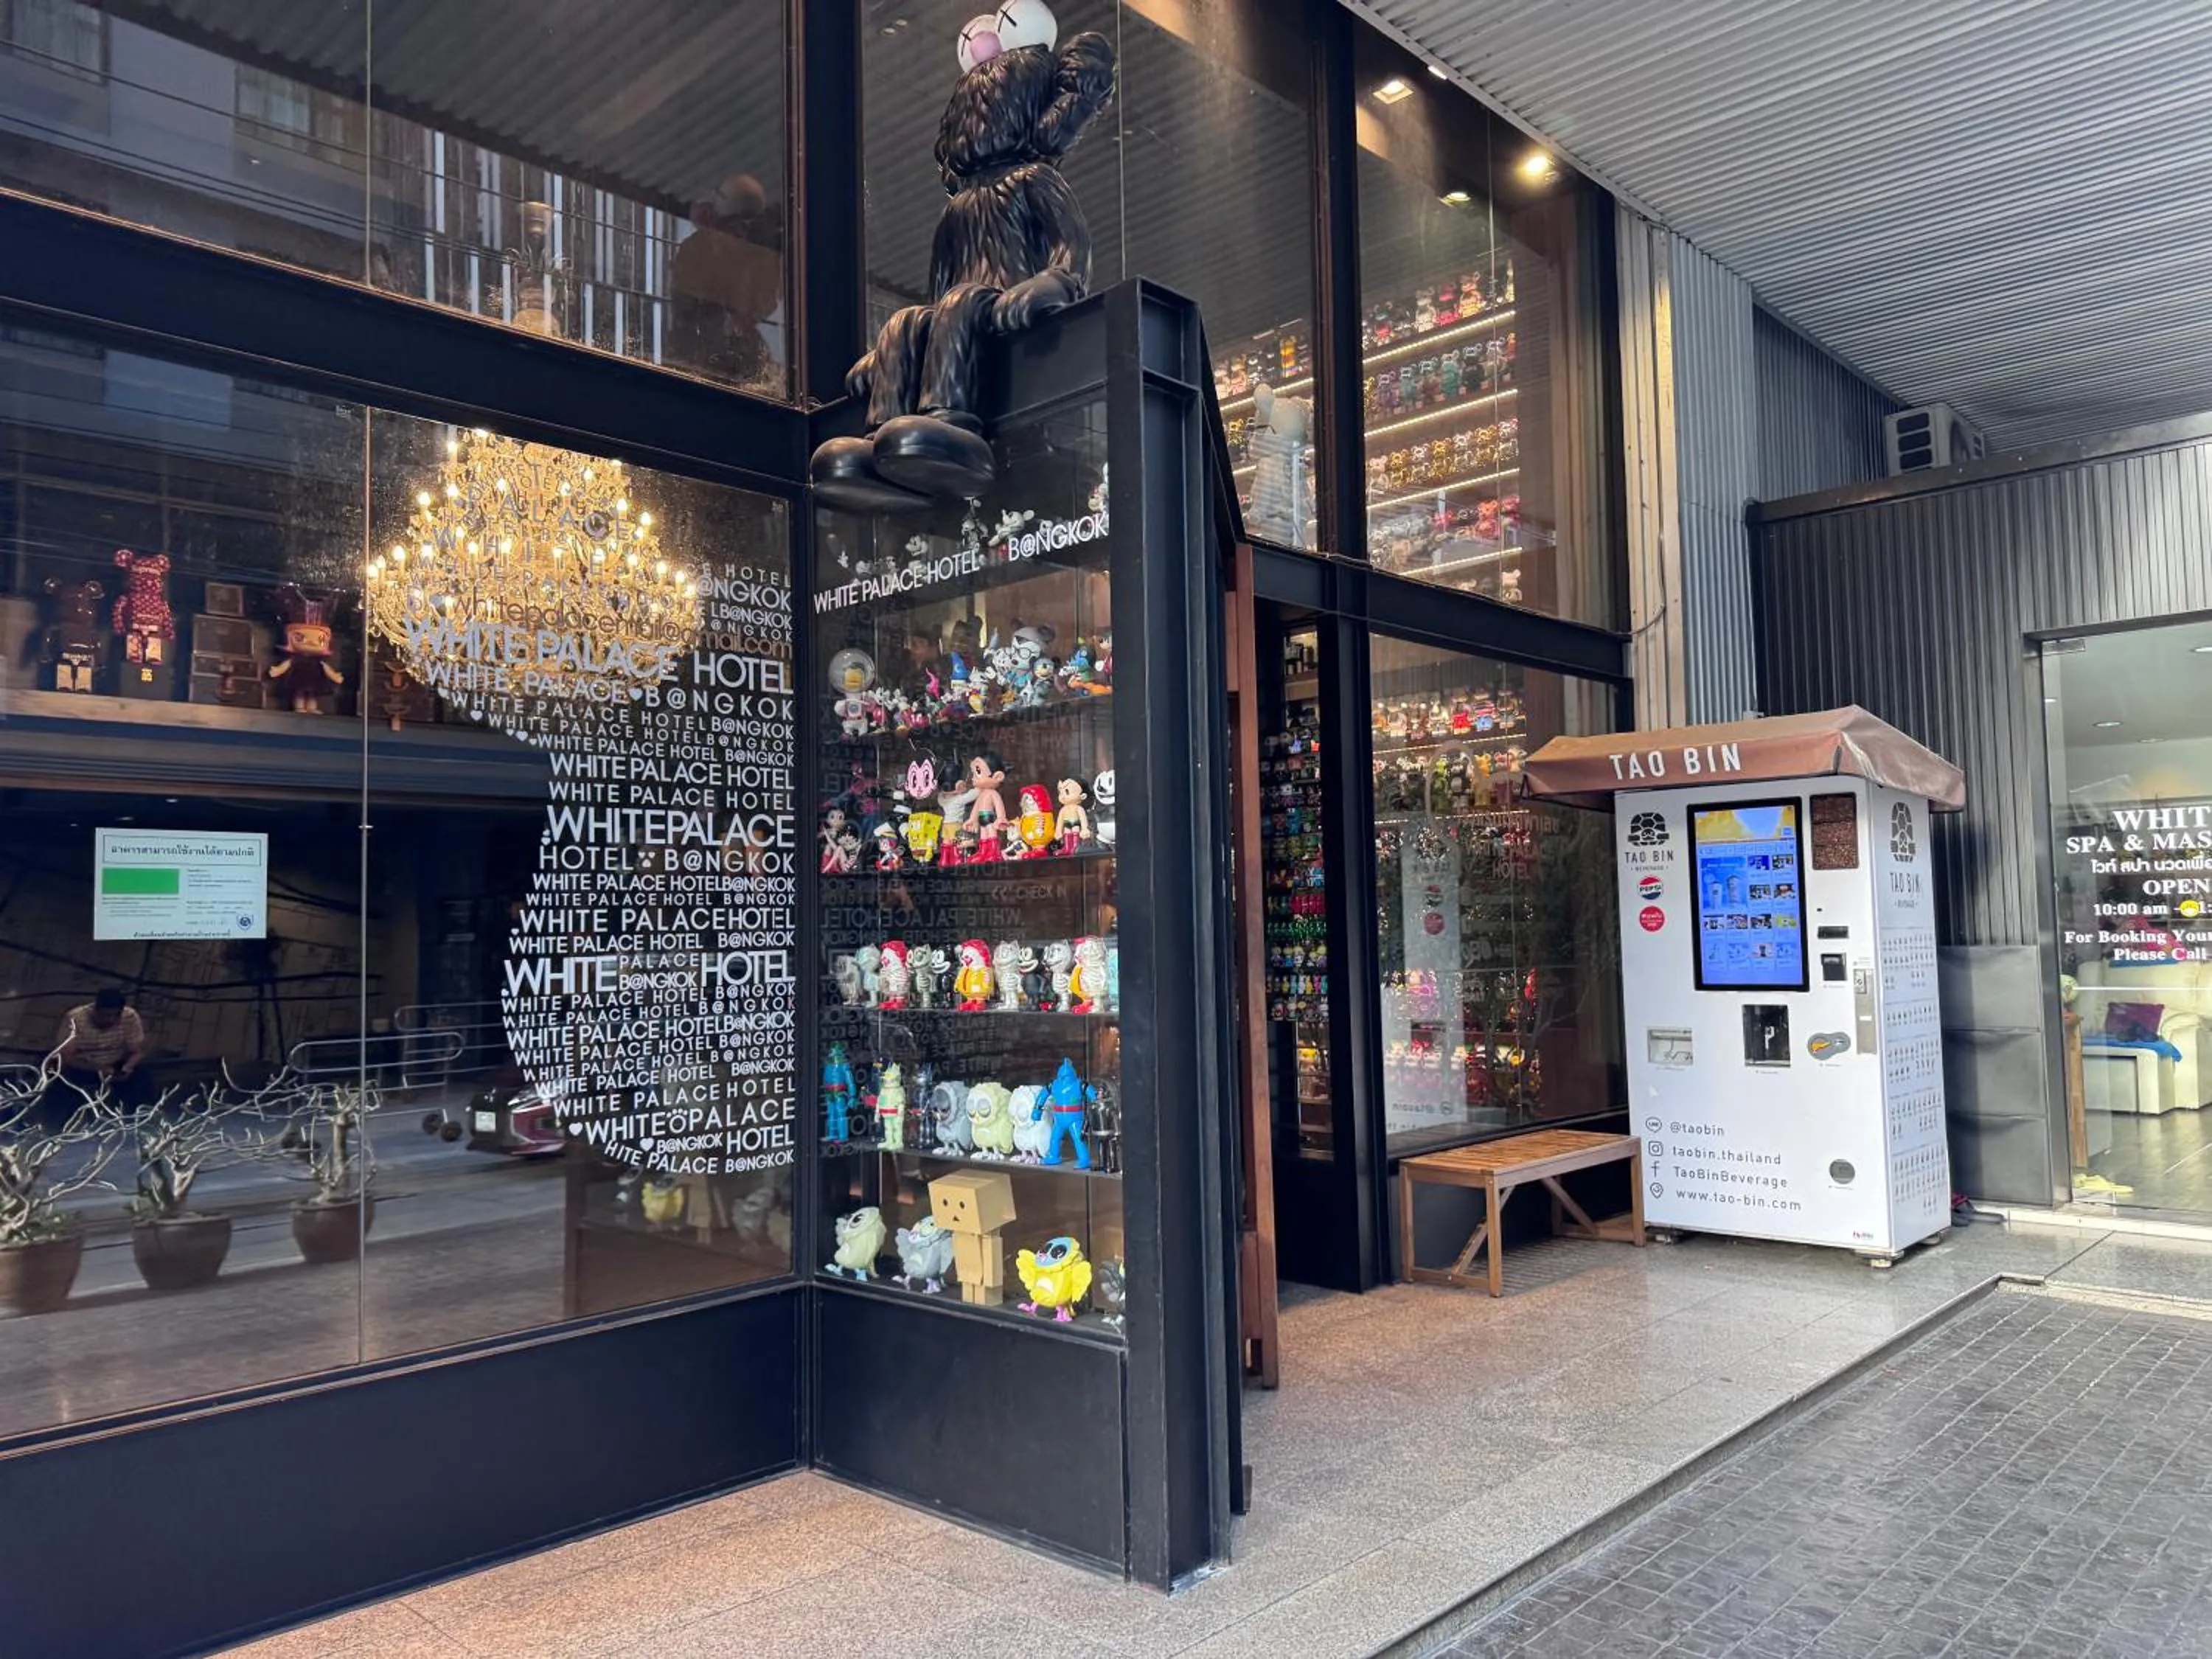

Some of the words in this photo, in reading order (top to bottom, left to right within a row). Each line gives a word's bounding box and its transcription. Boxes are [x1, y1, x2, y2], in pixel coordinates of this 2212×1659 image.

[725, 563, 790, 588] HOTEL
[813, 583, 859, 615] WHITE
[861, 566, 923, 603] PALACE
[927, 550, 980, 585] HOTEL
[403, 616, 528, 664] WHITE
[537, 628, 678, 681] PALACE
[694, 650, 794, 695] HOTEL
[425, 660, 510, 692] WHITE
[524, 670, 630, 704] PALACE
[645, 685, 793, 720] B@NGKOK
[451, 692, 524, 714] WHITE
[537, 700, 630, 723] PALACE
[641, 711, 706, 730] HOTEL
[488, 713, 549, 731] WHITE
[560, 721, 635, 738] PALACE
[538, 734, 593, 752] WHITE
[598, 739, 664, 757] PALACE
[670, 745, 717, 762] HOTEL
[725, 748, 793, 768] B@NGKOK
[1609, 749, 1666, 780] TAO
[1683, 742, 1741, 775] BIN
[549, 752, 626, 779] WHITE
[630, 757, 722, 785] PALACE
[727, 765, 795, 790] HOTEL
[549, 781, 619, 803] WHITE
[630, 785, 714, 807] PALACE
[726, 791, 794, 810] HOTEL
[1624, 852, 1646, 863] TAO
[1652, 850, 1674, 863] BIN
[2066, 835, 2115, 855] SPA
[2124, 834, 2145, 852] &
[540, 846, 633, 871] HOTEL
[664, 849, 795, 873] B@NGKOK
[533, 873, 591, 891] WHITE
[597, 874, 665, 891] PALACE
[2142, 878, 2211, 895] OPEN
[526, 893, 581, 906] WHITE
[588, 893, 657, 906] PALACE
[664, 893, 712, 905] HOTEL
[723, 893, 795, 906] B@NGKOK
[2093, 902, 2138, 917] 10:00
[2143, 905, 2168, 916] am
[520, 909, 608, 933] WHITE
[509, 936, 567, 954] WHITE
[573, 934, 643, 953] PALACE
[650, 933, 703, 950] HOTEL
[718, 932, 795, 948] B@NGKOK
[2065, 931, 2093, 944] For
[2098, 930, 2168, 945] Booking
[2113, 947, 2166, 961] Please
[2171, 947, 2207, 961] Call
[504, 955, 617, 997] WHITE
[619, 953, 700, 970] PALACE
[702, 949, 796, 987] HOTEL
[619, 972, 698, 991] B@NGKOK
[502, 995, 562, 1015] WHITE
[571, 990, 644, 1009] PALACE
[653, 987, 707, 1004] HOTEL
[716, 982, 795, 1000] B@NGKOK
[502, 1013, 556, 1032] WHITE
[566, 1009, 631, 1026] PALACE
[639, 1004, 690, 1019] HOTEL
[698, 997, 795, 1015] B@NGKOK
[507, 1027, 574, 1051] WHITE
[579, 1020, 660, 1044] PALACE
[515, 1048, 574, 1067] WHITE
[580, 1042, 653, 1060] PALACE
[659, 1034, 713, 1052] HOTEL
[719, 1029, 795, 1048] B@NGKOK
[581, 1056, 645, 1075] PALACE
[652, 1051, 703, 1067] HOTEL
[711, 1043, 795, 1062] B@NGKOK
[535, 1077, 588, 1099] WHITE
[597, 1071, 659, 1091] PALACE
[668, 1063, 716, 1083] HOTEL
[731, 1059, 795, 1077] B@NGKOK
[553, 1094, 620, 1118] WHITE
[633, 1084, 720, 1109] PALACE
[727, 1077, 796, 1097] HOTEL
[585, 1112, 665, 1145] WHITE
[690, 1098, 796, 1131] PALACE
[1669, 1121, 1725, 1137] @taobin
[657, 1133, 723, 1155] B@NGKOK
[726, 1124, 794, 1155] HOTEL
[647, 1154, 717, 1174] PALACE
[725, 1149, 794, 1174] B@NGKOK
[1672, 1145, 1781, 1165] taobin.thailand
[1674, 1166, 1788, 1189] TaoBinBeverage
[1676, 1189, 1801, 1211] www.tao-bin.com
